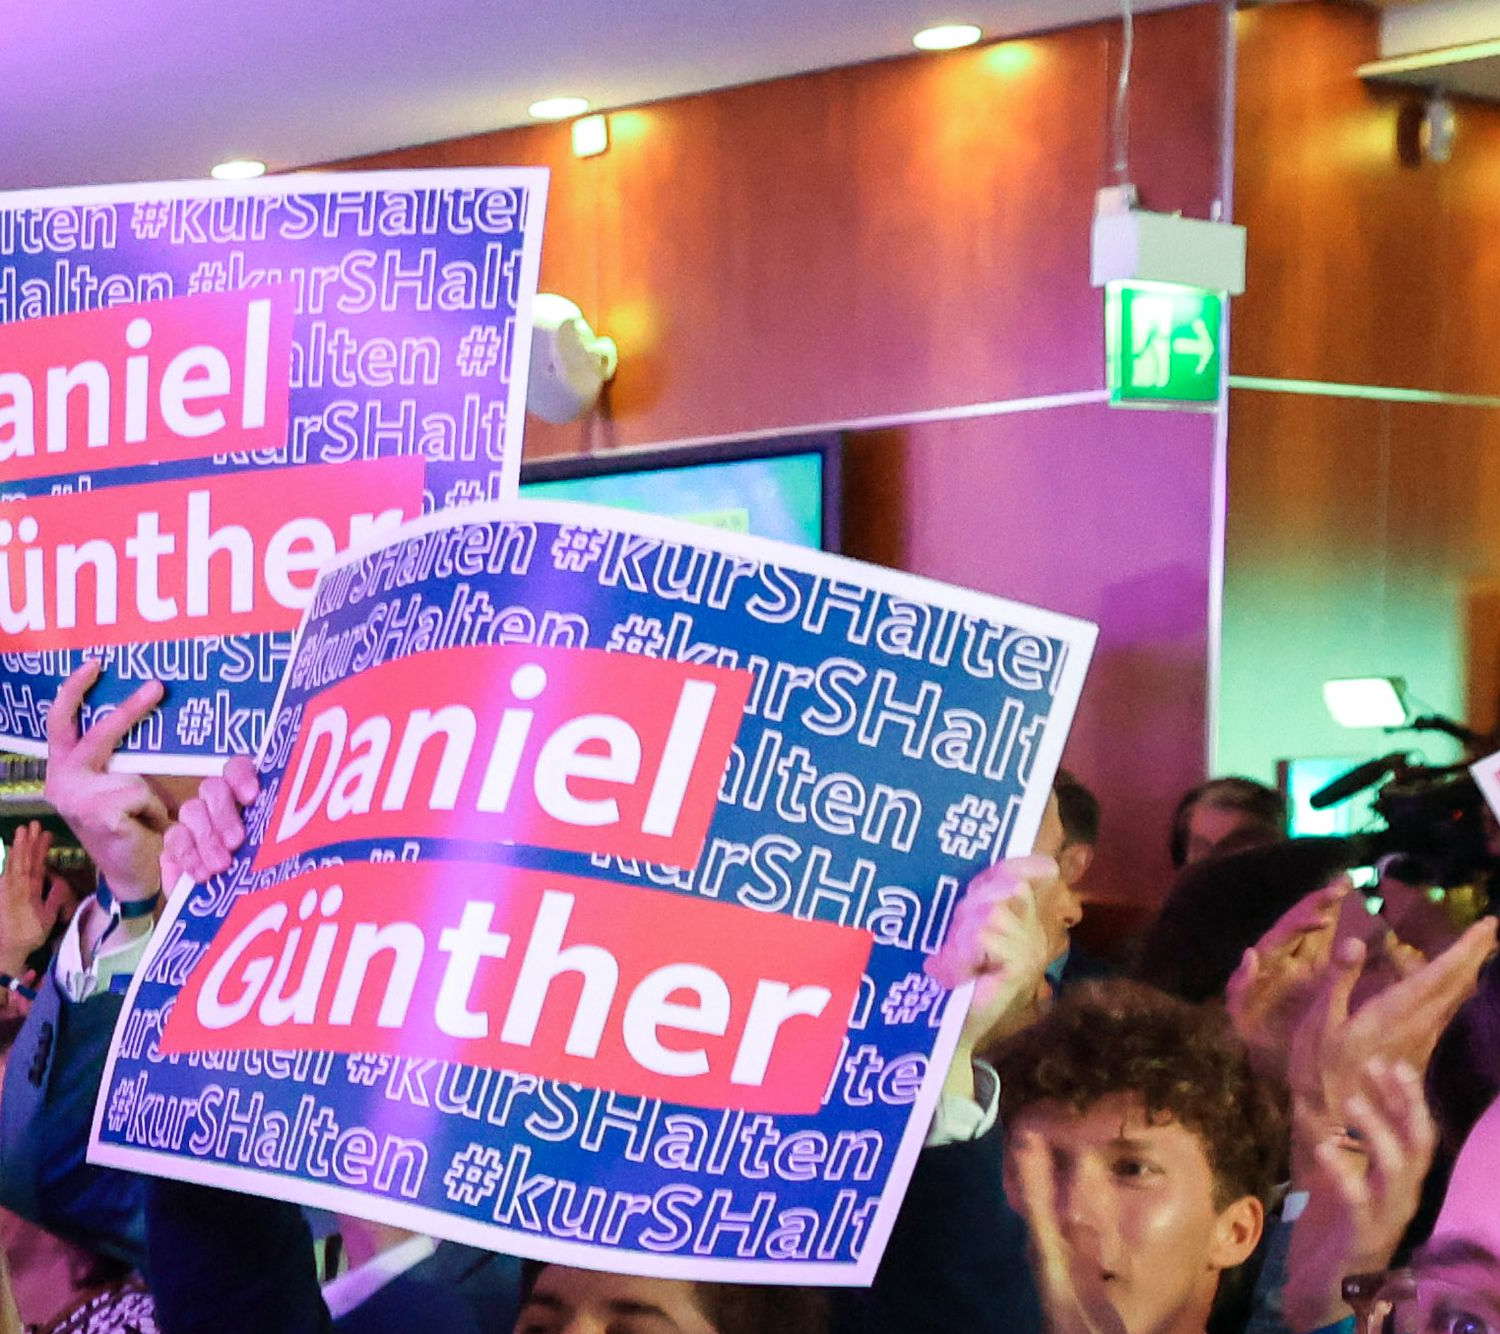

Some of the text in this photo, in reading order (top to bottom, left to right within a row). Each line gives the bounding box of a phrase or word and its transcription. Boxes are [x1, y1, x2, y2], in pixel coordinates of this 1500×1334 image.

[130, 187, 529, 244] #kurSHalte
[550, 522, 1070, 698] #kurSHalte
[275, 662, 717, 844] Daniel
[195, 883, 833, 1087] Günther
[107, 1070, 429, 1200] #kurSHalten
